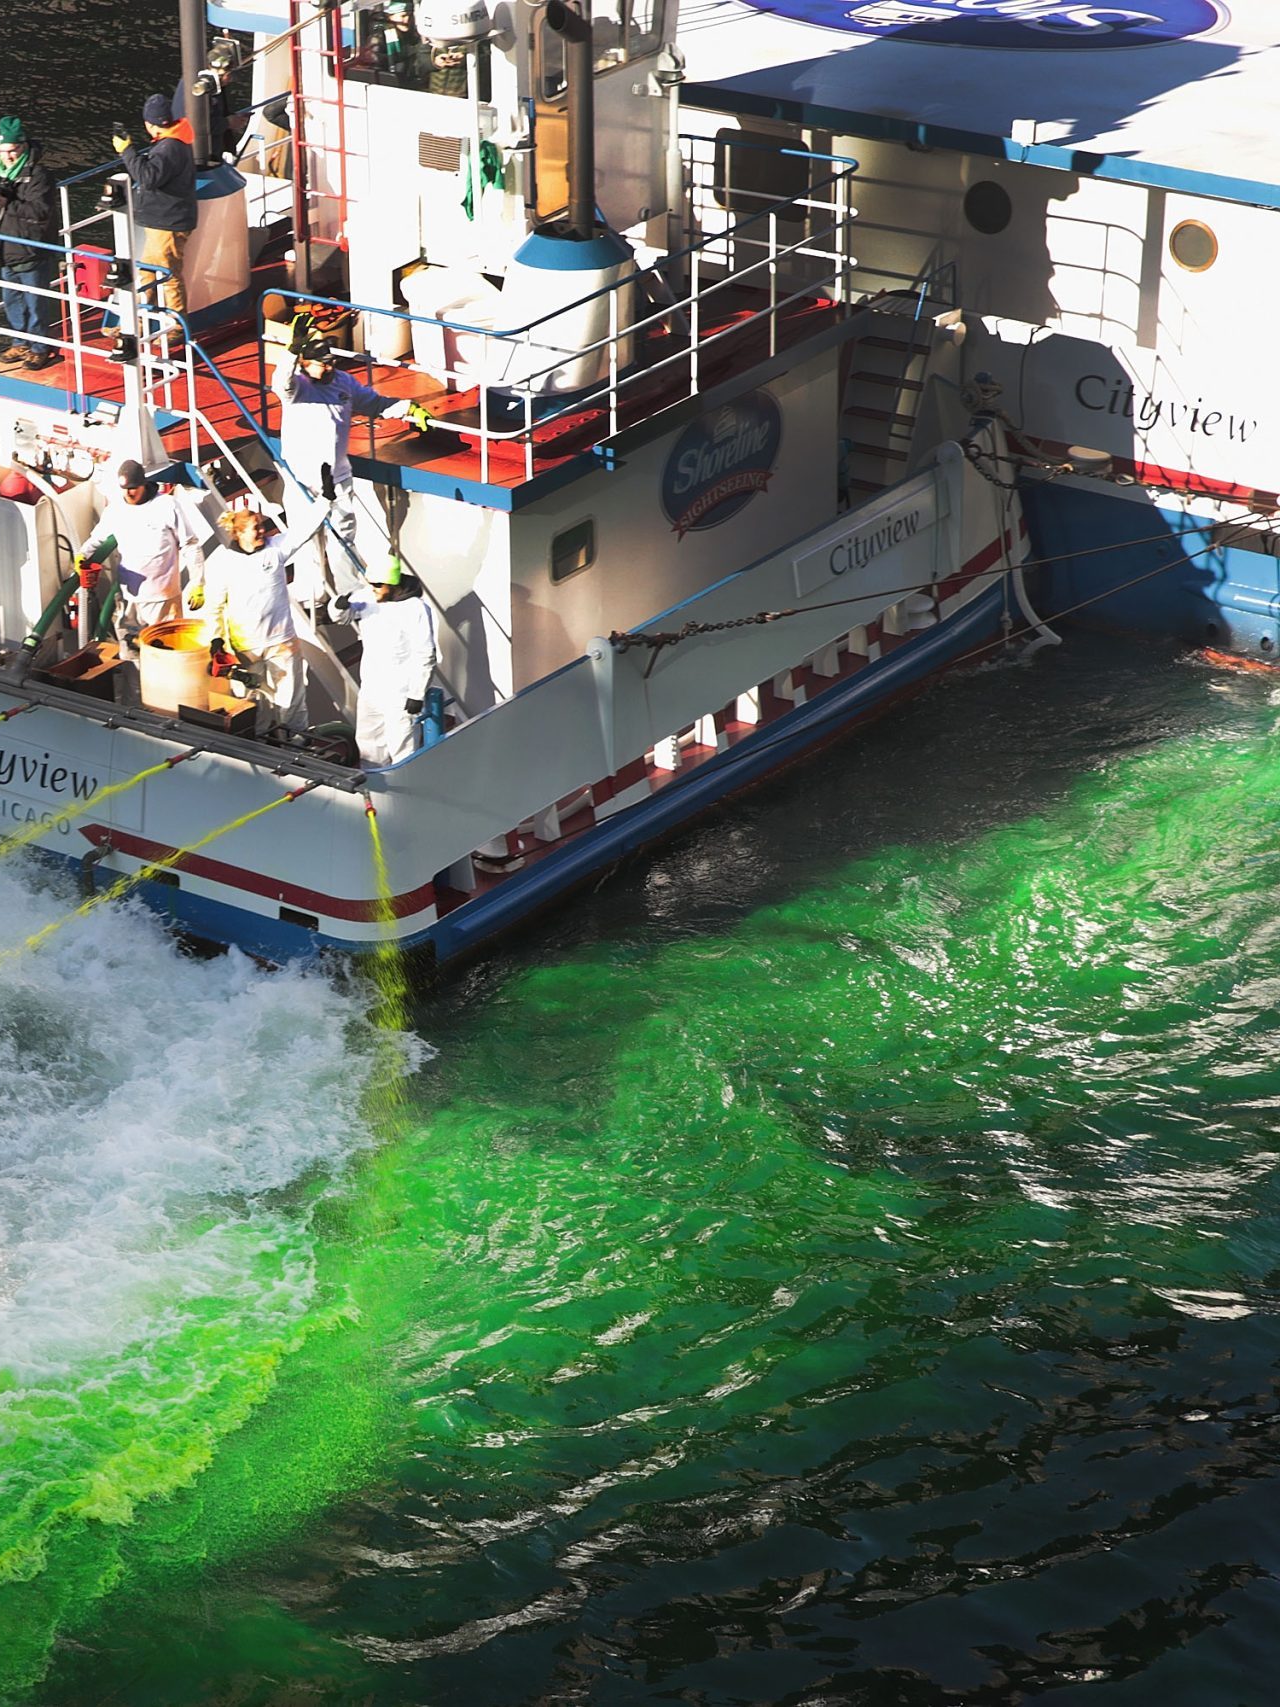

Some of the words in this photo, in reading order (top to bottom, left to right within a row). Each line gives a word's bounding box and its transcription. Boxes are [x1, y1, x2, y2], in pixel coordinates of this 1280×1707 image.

[1074, 374, 1257, 443] Cityview
[673, 420, 770, 495] Shoreline
[679, 471, 765, 526] SIGHTSEEING
[829, 510, 920, 576] Cityview
